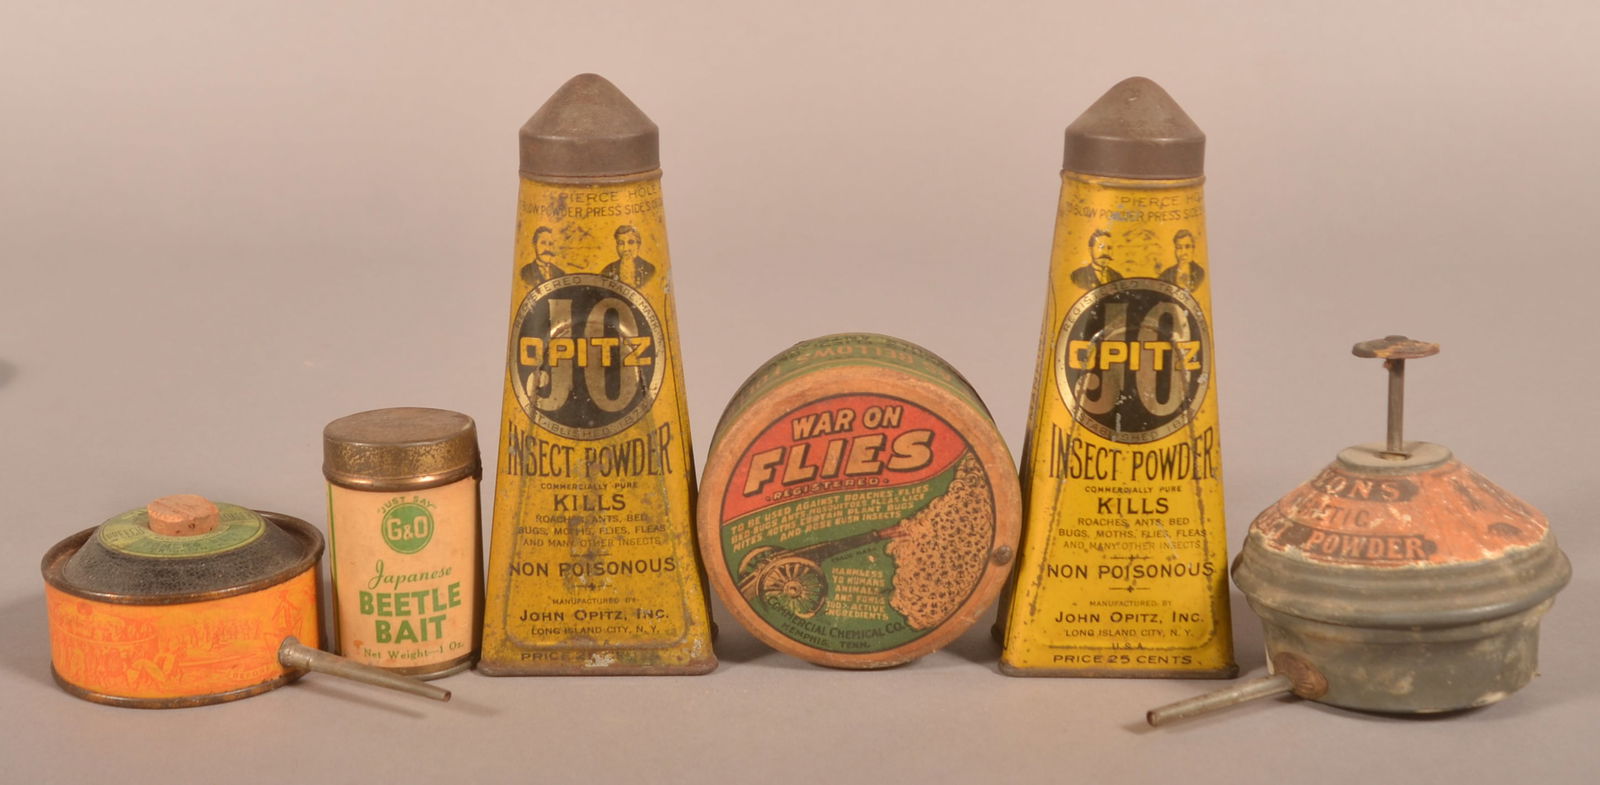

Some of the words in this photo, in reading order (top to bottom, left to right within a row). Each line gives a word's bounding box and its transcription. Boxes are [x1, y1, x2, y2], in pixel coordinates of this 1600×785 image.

[519, 336, 652, 367] OPITZ
[1068, 340, 1201, 371] OPITZ
[791, 408, 855, 441] WAR
[863, 405, 903, 428] ON
[507, 420, 575, 478] INSECT
[584, 421, 673, 478] POWDER
[1049, 423, 1122, 481] INSECT
[1131, 426, 1215, 481] POWDER
[743, 429, 936, 498] FLIES
[773, 477, 880, 501] REGISTERED
[553, 493, 627, 512] KILLS
[1097, 497, 1170, 515] KILLS
[626, 514, 648, 522] BED
[730, 522, 744, 534] TO
[764, 506, 792, 522] USED
[1169, 517, 1190, 526] BED
[387, 516, 428, 541] G&O
[780, 527, 802, 542] AND
[1176, 529, 1207, 537] FLEAS
[523, 538, 544, 547] AND
[1063, 541, 1085, 549] AND
[1121, 541, 1155, 549] OTHER
[1304, 530, 1427, 560] POWDER
[368, 559, 453, 591] Japanese
[509, 562, 549, 577] NON
[559, 557, 676, 577] POISONOUS
[1047, 564, 1088, 579] NON
[1098, 562, 1216, 579] POISONOUS
[358, 582, 462, 617] BEETLE
[519, 609, 565, 622] JOHN
[574, 609, 628, 622] OPITZ,
[636, 608, 669, 620] INC.
[767, 595, 826, 637] COMMERCIAL
[829, 626, 885, 639] CHEMICAL
[885, 622, 906, 634] CO.
[1055, 611, 1100, 623] JOHN
[1110, 611, 1163, 624] OPITZ,
[1172, 611, 1204, 623] INC.
[375, 614, 447, 644] BAIT
[531, 627, 560, 636] LONG
[564, 626, 601, 634] ISLAND
[1065, 629, 1094, 637] LONG
[1098, 629, 1136, 637] ISLAND
[364, 647, 382, 659] Net
[1053, 655, 1103, 664] PRICE
[1106, 655, 1130, 664] 25
[1136, 655, 1193, 665] CENTS
